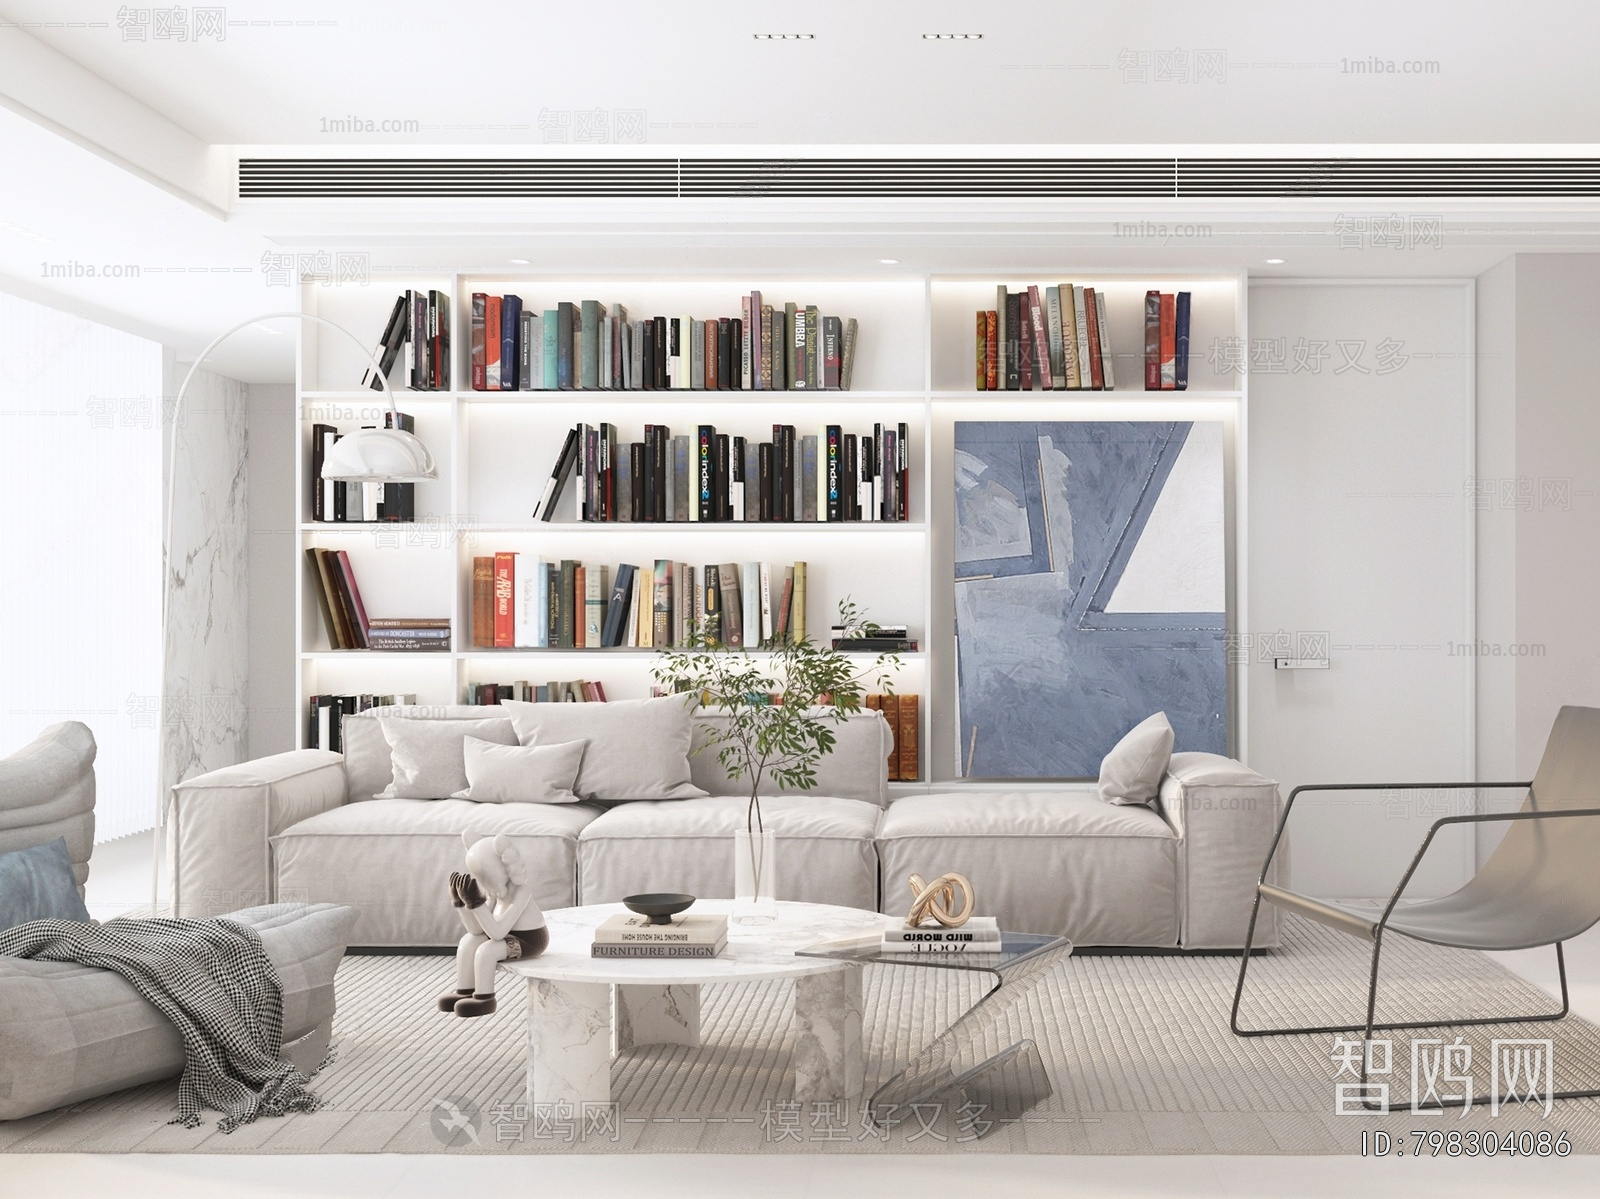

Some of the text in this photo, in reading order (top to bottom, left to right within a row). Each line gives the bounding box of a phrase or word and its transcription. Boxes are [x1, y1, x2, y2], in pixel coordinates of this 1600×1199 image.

[806, 309, 817, 324] The
[1031, 306, 1043, 331] Blood
[796, 312, 806, 348] UMBRA
[826, 334, 835, 360] INFERNO
[1062, 320, 1075, 380] BAROQUE
[496, 576, 511, 598] ARAB
[593, 947, 714, 956] FURNITURE DESIGN
